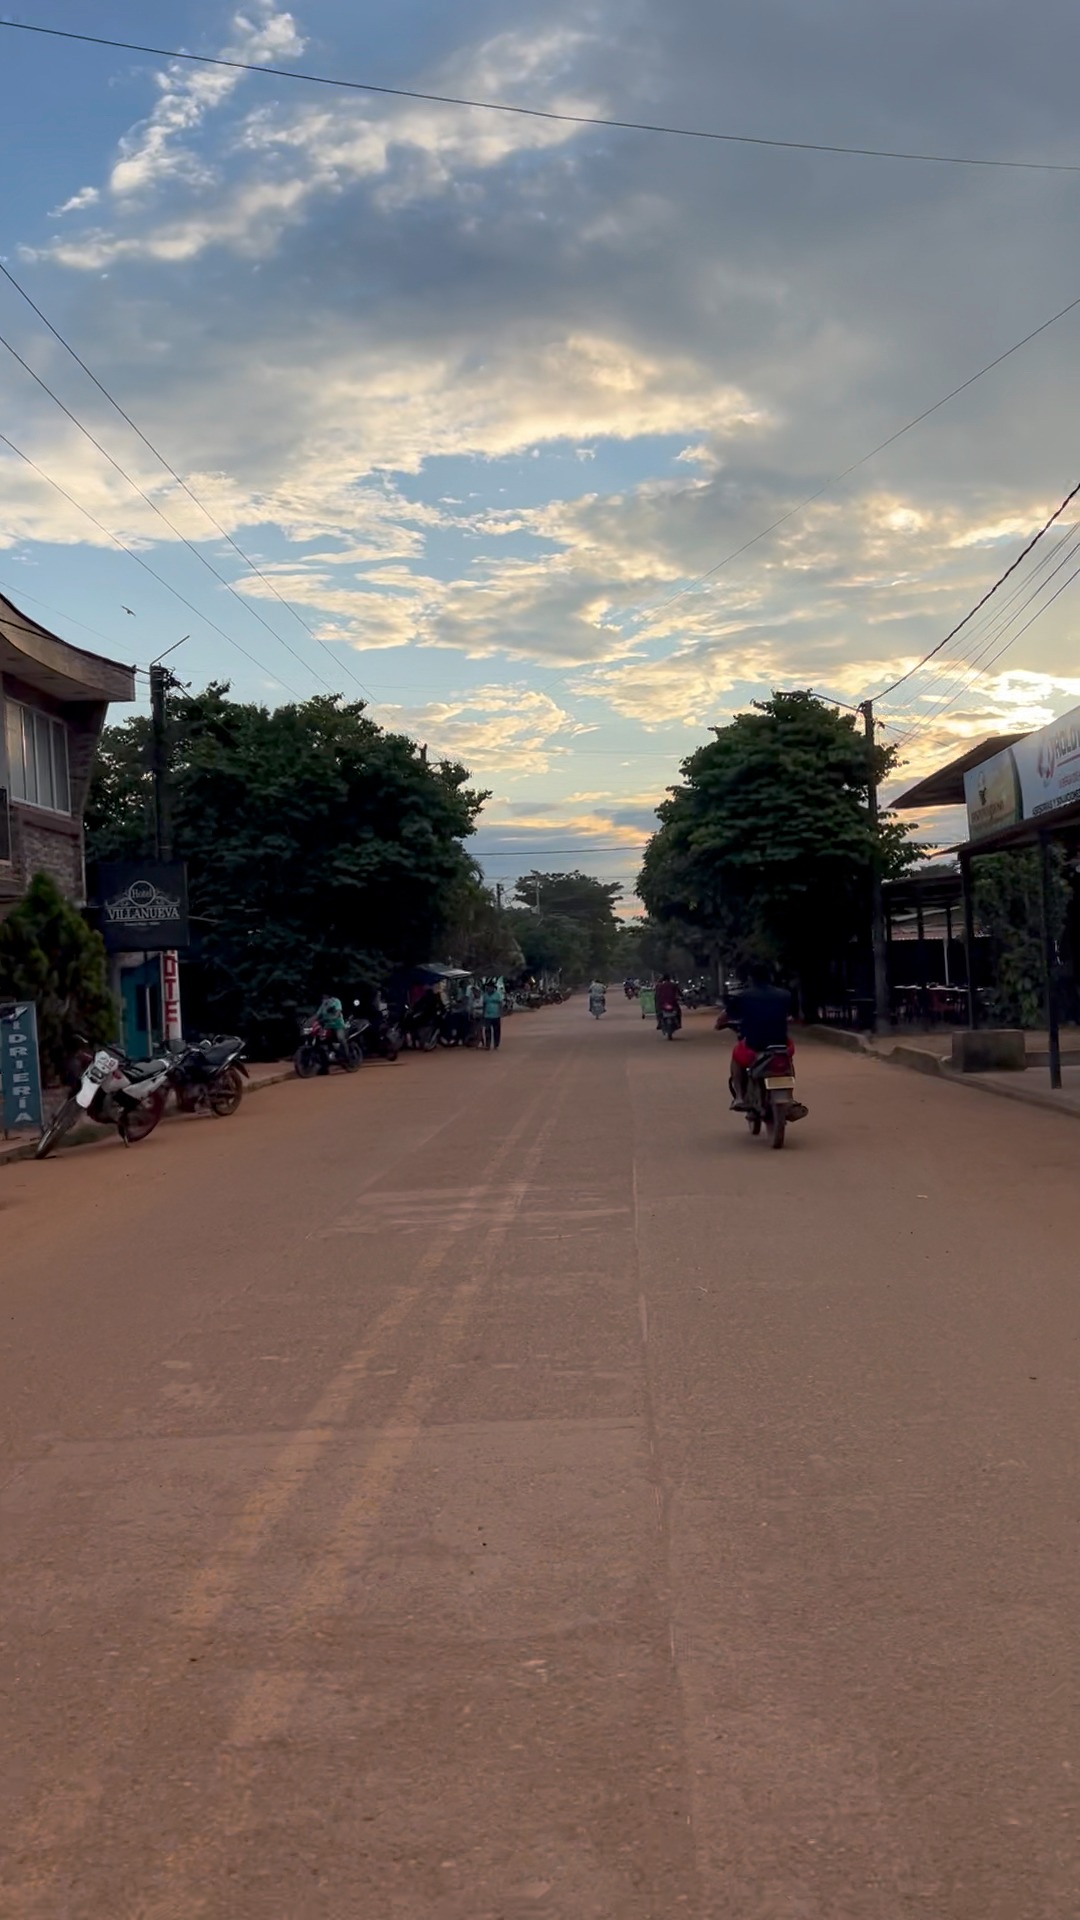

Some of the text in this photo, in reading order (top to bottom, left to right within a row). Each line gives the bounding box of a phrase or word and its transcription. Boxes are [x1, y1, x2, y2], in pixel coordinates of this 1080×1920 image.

[132, 888, 153, 899] Hotel
[107, 907, 180, 920] VILLANUEVA
[163, 951, 178, 1040] OTEL
